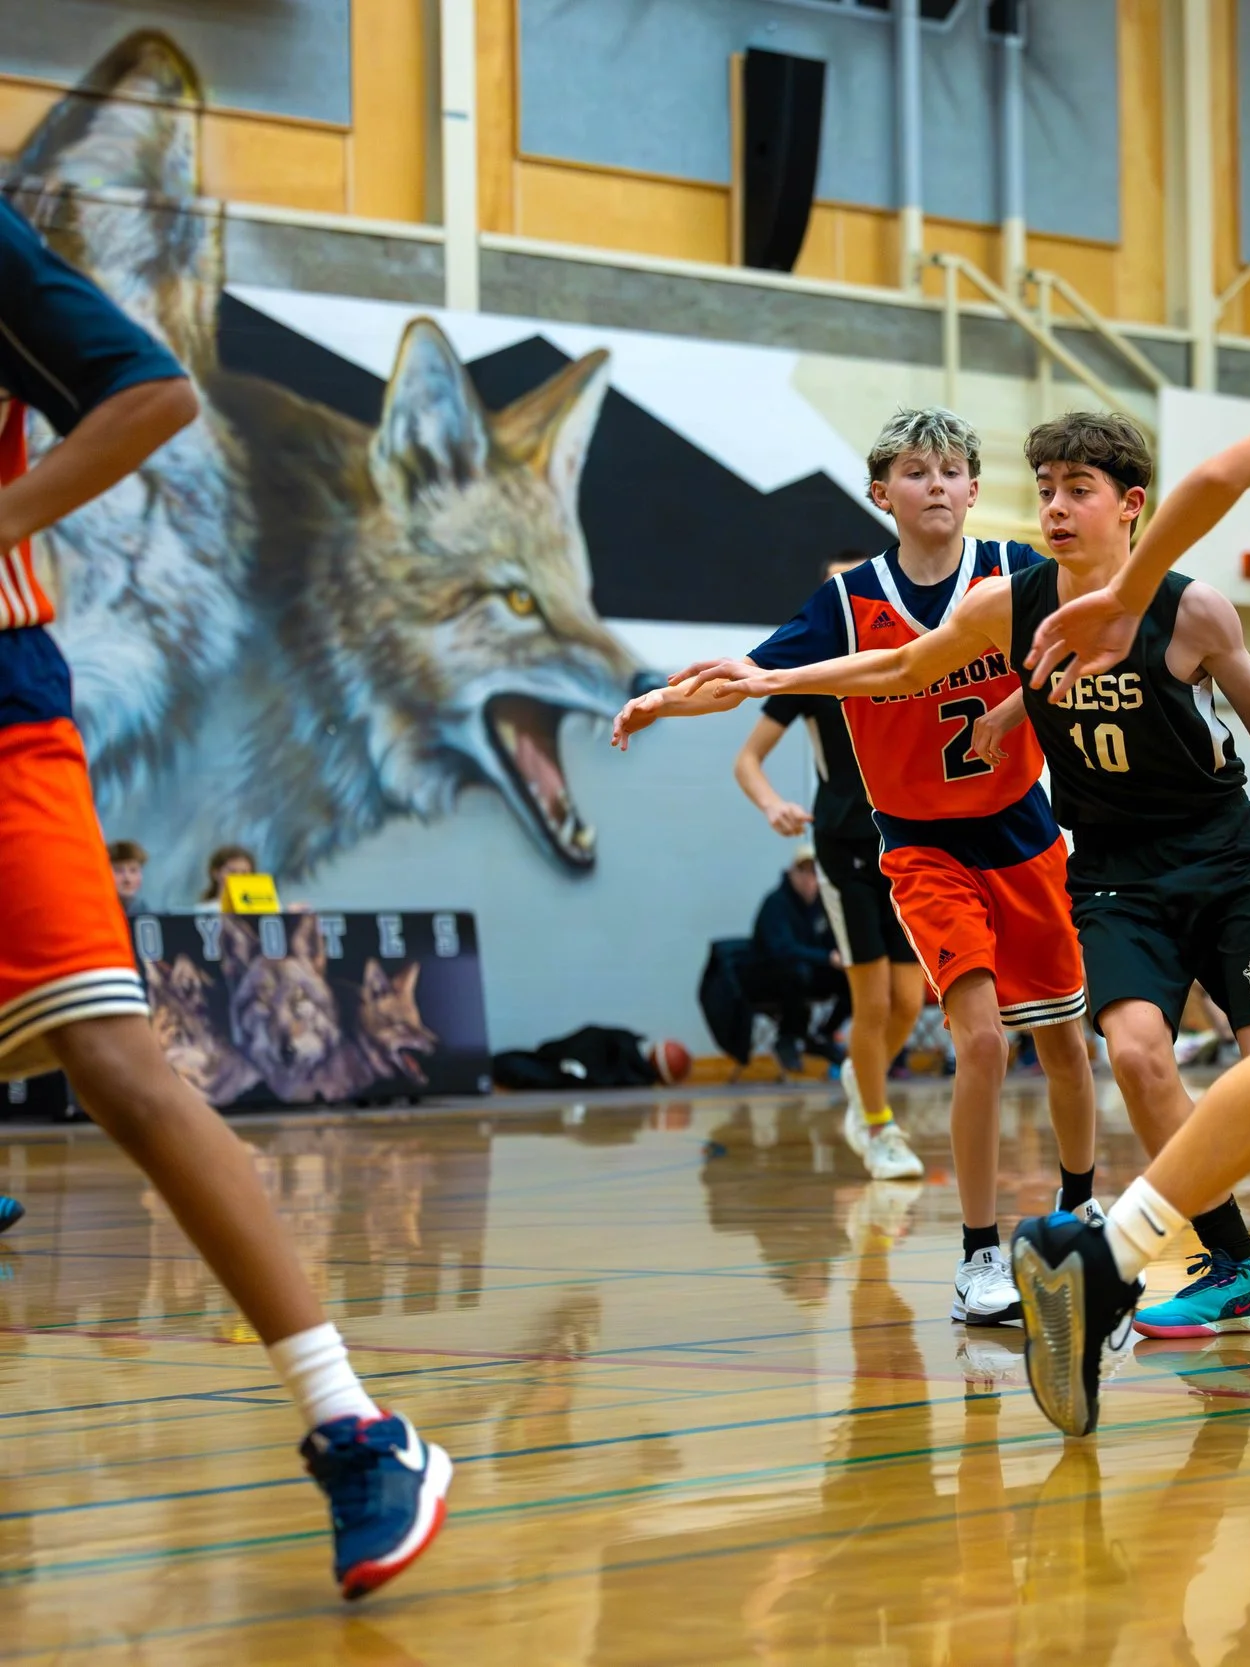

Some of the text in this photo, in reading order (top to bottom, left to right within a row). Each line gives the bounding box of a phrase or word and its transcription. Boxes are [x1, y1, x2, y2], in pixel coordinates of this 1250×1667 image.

[871, 620, 896, 630] adidas
[938, 696, 994, 782] 2
[1069, 722, 1130, 773] 10
